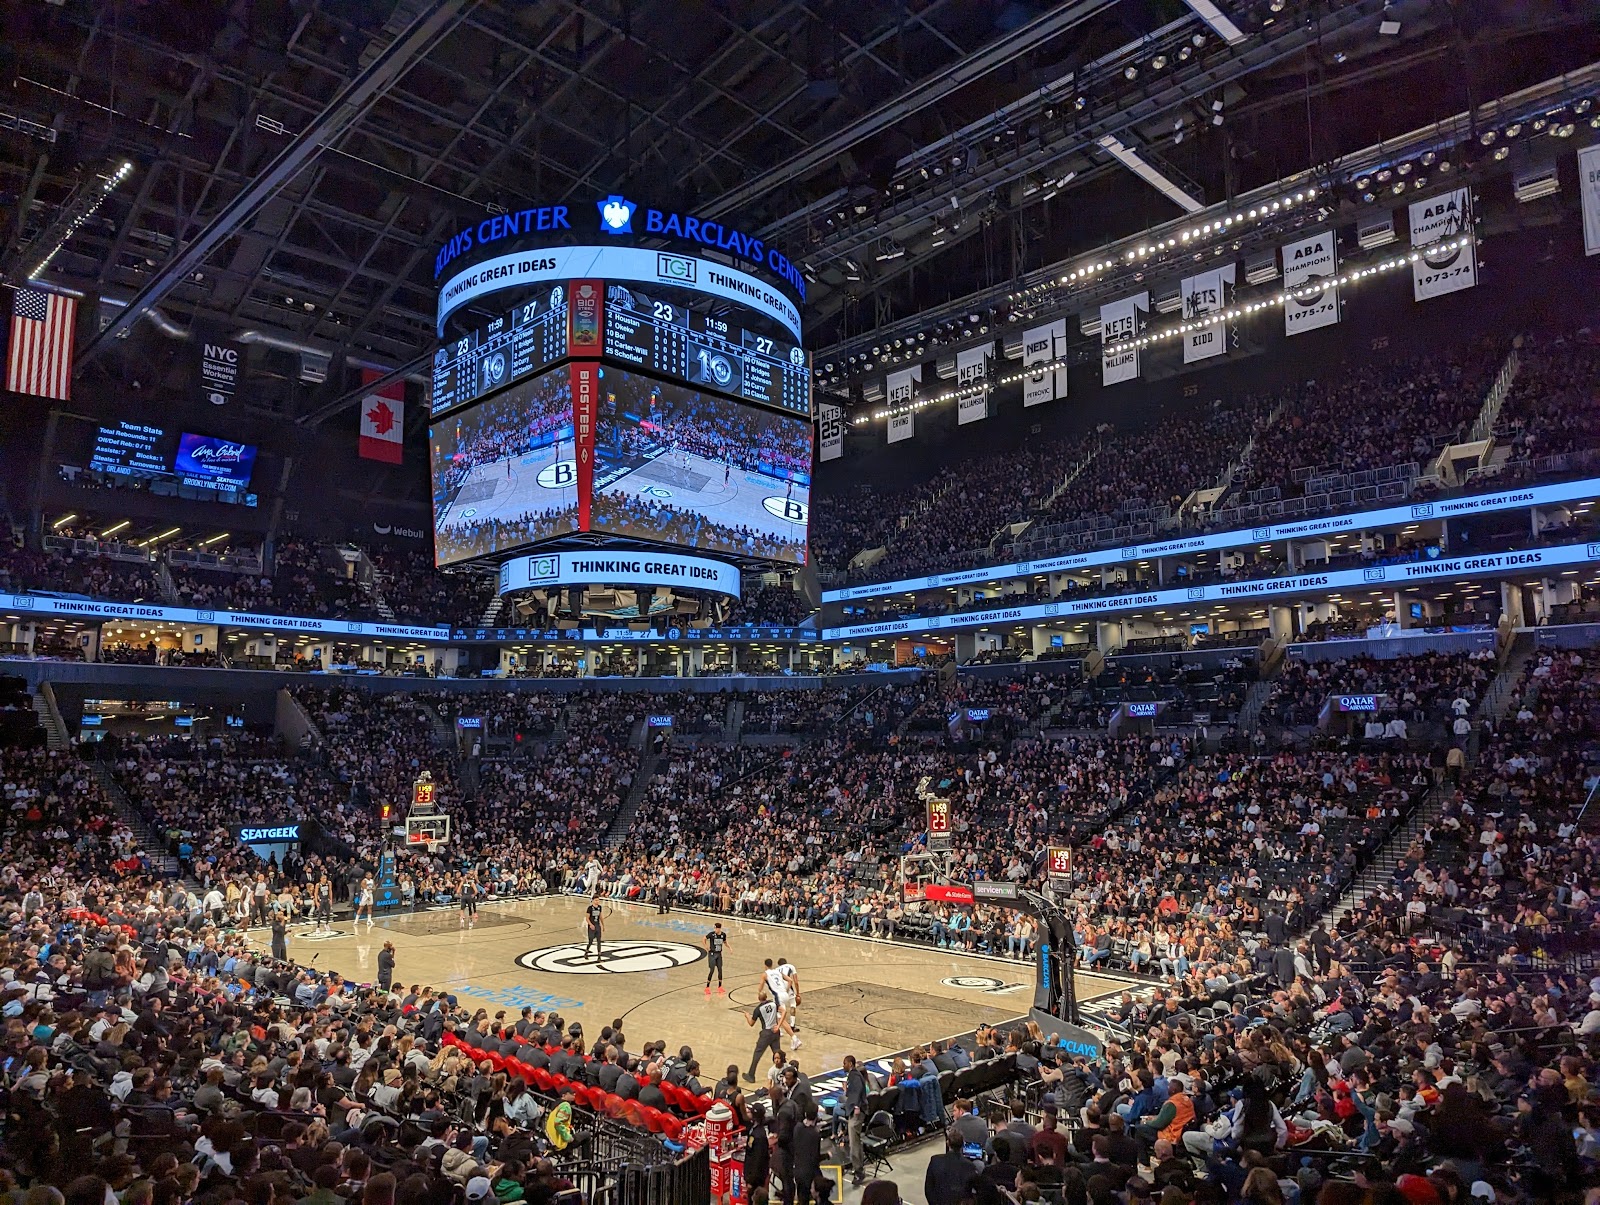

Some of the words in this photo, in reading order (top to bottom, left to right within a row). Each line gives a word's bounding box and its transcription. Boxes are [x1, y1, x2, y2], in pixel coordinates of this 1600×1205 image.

[1424, 201, 1456, 219] ABA
[478, 206, 571, 244] CENTER
[647, 209, 764, 262] BARCLAYS
[1294, 243, 1323, 260] ABA
[662, 258, 692, 278] TGI
[1285, 256, 1330, 273] CHAMPIONS
[445, 274, 478, 303] THINKING
[480, 264, 514, 283] GREAT
[518, 258, 556, 273] IDEAS
[1418, 266, 1470, 286] 1973-74
[709, 272, 761, 300] THINKING
[764, 293, 786, 315] GREAT
[788, 308, 799, 330] IDEAS
[523, 301, 537, 322] 27
[653, 302, 673, 321] 23
[1289, 304, 1334, 321] 1975-76
[488, 318, 503, 332] 11:59
[615, 313, 640, 327] Houstan
[705, 317, 727, 332] 11:59
[1105, 316, 1132, 335] NETS
[615, 322, 634, 334] Okeke
[615, 331, 625, 340] Bol
[1193, 332, 1213, 346] KIDD
[204, 344, 238, 362] NYC
[457, 338, 468, 356] 23
[756, 337, 774, 355] 27
[1027, 340, 1048, 357] NETS
[606, 347, 614, 355] 25
[614, 349, 643, 363] Schofield
[1106, 353, 1134, 369] WILLIAMS
[203, 361, 236, 375] Essential
[203, 368, 233, 380] Workers
[961, 363, 982, 380] NETS
[751, 374, 772, 386] Johnson
[751, 381, 765, 392] Curry
[751, 389, 770, 401] Claxton
[890, 385, 909, 400] NETS
[1027, 388, 1050, 399] PETROVIC
[580, 371, 590, 444] BIOSTEEL
[960, 397, 984, 409] WILLIAMSON
[822, 408, 839, 421] NETS
[120, 422, 141, 432] Team
[143, 426, 162, 436] Stats
[893, 417, 908, 428] ERVING
[100, 427, 115, 435] Total
[116, 430, 148, 440] Rebounds:
[822, 420, 839, 440] 25
[96, 446, 121, 455] Assists:
[136, 452, 159, 460] Blocks:
[93, 455, 115, 463] Steals:
[129, 460, 160, 469] Turnovers:
[107, 465, 131, 474] ORLANDO
[184, 478, 237, 492] BROOKLYNNETS.COM
[216, 477, 244, 486] SEATGEEK
[1440, 502, 1478, 512] THINKING
[1481, 497, 1507, 506] GREAT
[1509, 493, 1534, 502] IDEAS
[393, 526, 424, 538] Webull
[1276, 526, 1308, 535] THINKING
[1309, 522, 1330, 531] GREAT
[1332, 519, 1353, 527] IDEAS
[1141, 546, 1168, 554] THINKING
[1188, 540, 1205, 548] IDEAS
[532, 559, 556, 575] TGI
[572, 561, 640, 573] THINKING
[644, 562, 686, 576] GREAT
[690, 567, 718, 580] IDEAS
[1406, 562, 1461, 575] THINKING
[1464, 557, 1502, 569] GREAT
[1506, 553, 1542, 565] IDEAS
[1221, 582, 1264, 595] THINKING
[1266, 579, 1297, 589] GREAT
[1299, 576, 1328, 587] IDEAS
[54, 602, 100, 612] THINKING
[104, 605, 134, 615] GREAT
[137, 608, 163, 616] IDEAS
[1072, 602, 1106, 611] THINKING
[1108, 598, 1133, 607] GREAT
[1134, 595, 1158, 604] IDEAS
[231, 615, 270, 625] THINKING
[273, 618, 297, 627] GREAT
[300, 620, 321, 628] IDEAS
[950, 616, 979, 624] THINKING
[981, 613, 1000, 621] GREAT
[1002, 610, 1021, 618] IDEAS
[376, 626, 407, 636] THINKING
[411, 629, 431, 637] GREAT
[1130, 704, 1155, 713] QATAR
[1341, 697, 1374, 707] QATAR
[418, 792, 430, 802] 23
[933, 813, 946, 829] 23
[241, 826, 299, 841] SEATGEEK
[1055, 859, 1067, 869] 23
[765, 1005, 773, 1013] 23
[1046, 1035, 1097, 1057] RCLAYS
[706, 1123, 720, 1131] BIO
